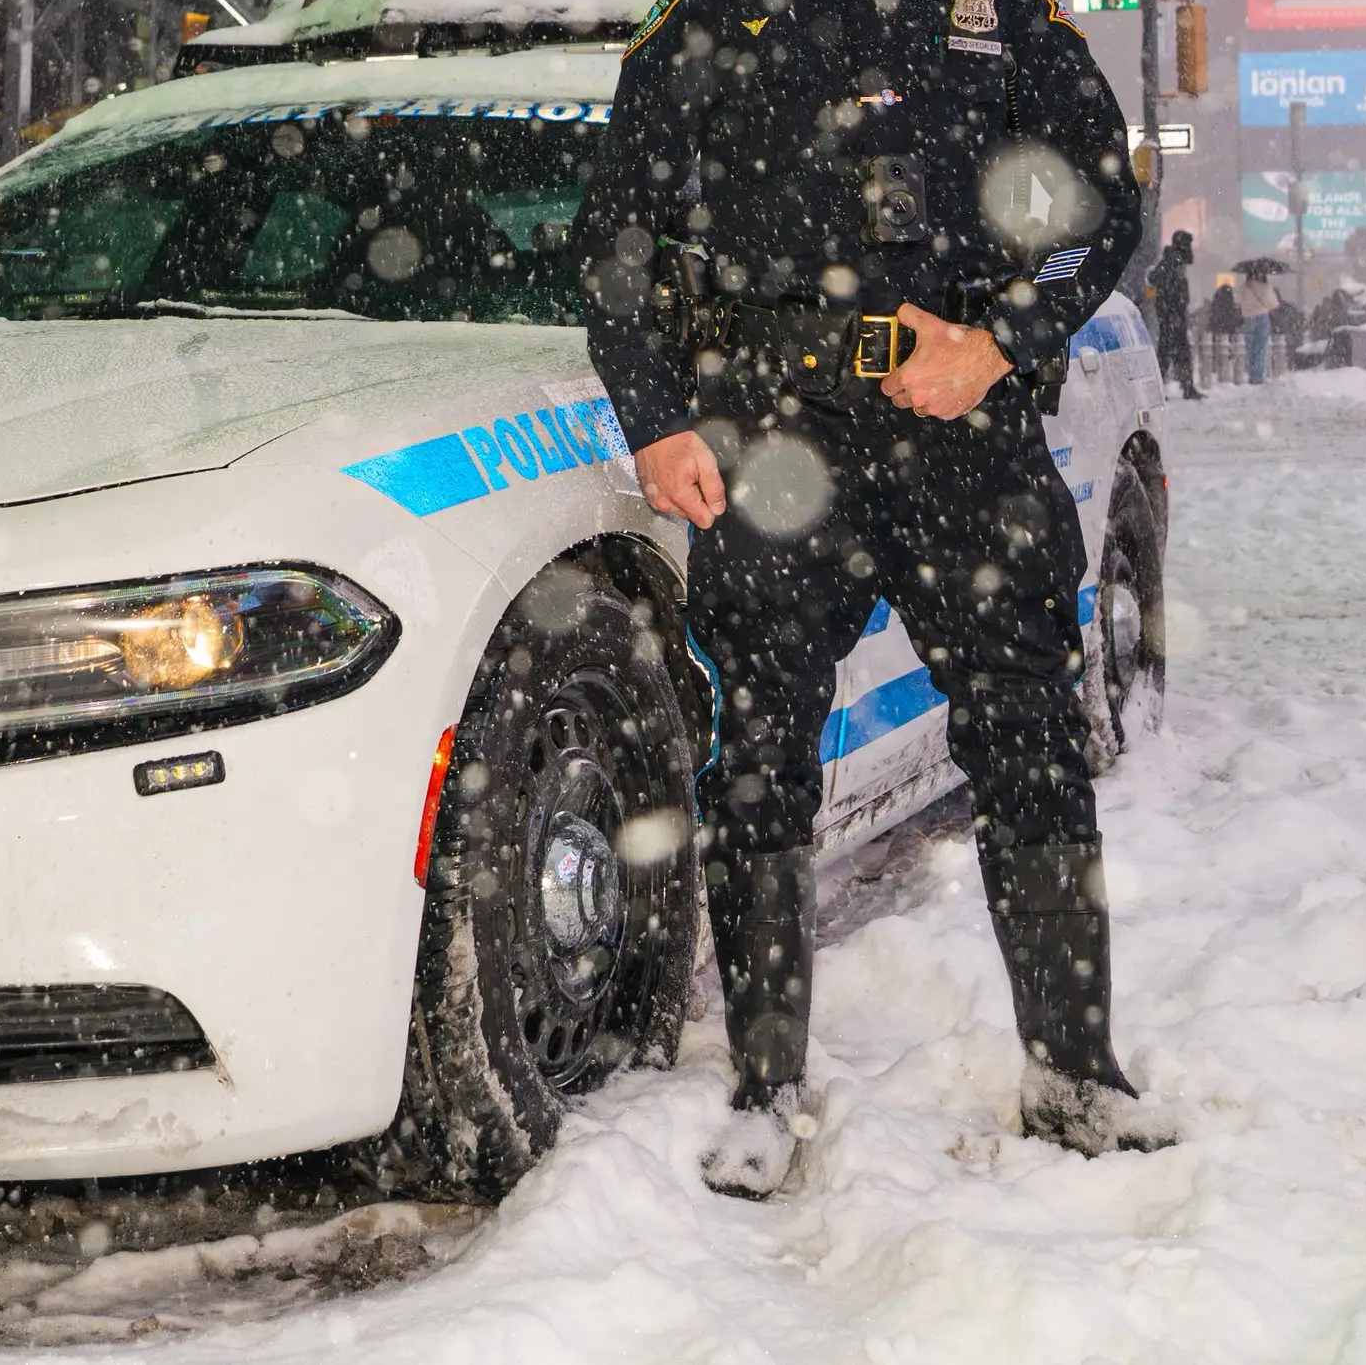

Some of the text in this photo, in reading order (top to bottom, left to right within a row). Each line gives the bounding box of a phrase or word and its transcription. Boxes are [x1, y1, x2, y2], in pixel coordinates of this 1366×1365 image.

[641, 14, 664, 36] YORK
[957, 14, 992, 28] 23674
[1250, 68, 1347, 97] Ionian
[1307, 204, 1363, 217] FOR ALL
[1320, 217, 1348, 229] THE
[461, 396, 612, 492] POLICE
